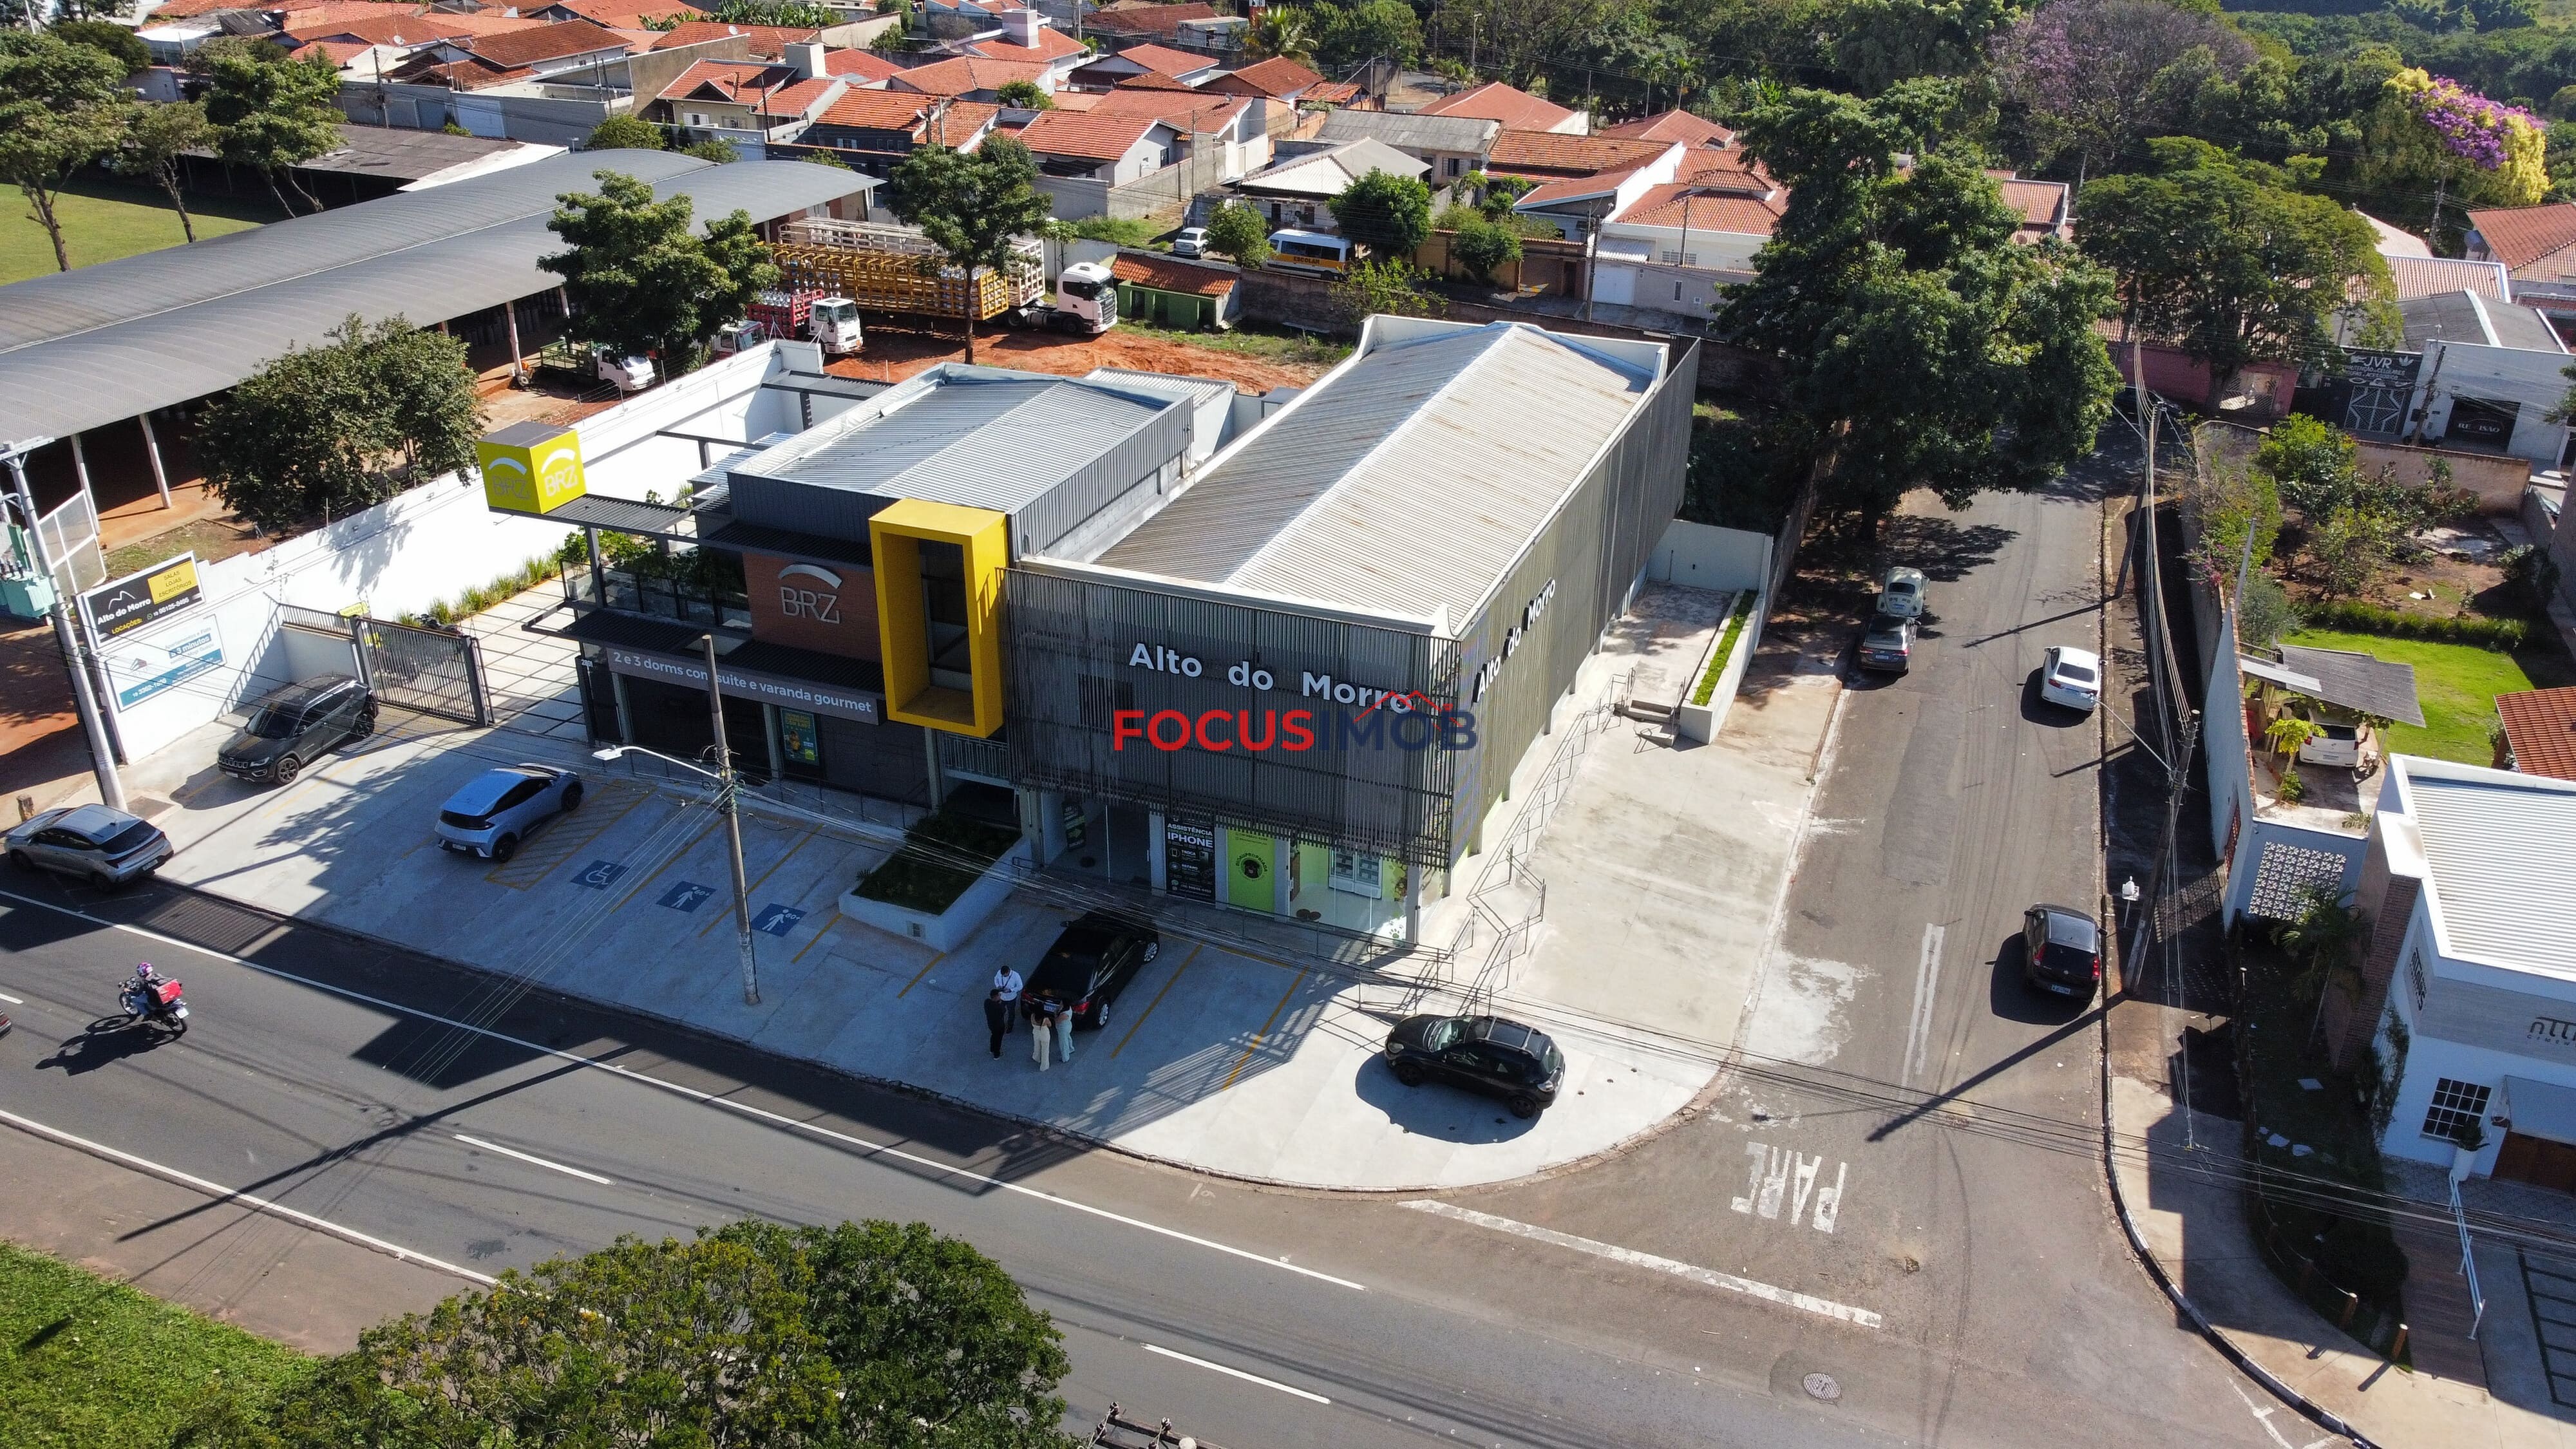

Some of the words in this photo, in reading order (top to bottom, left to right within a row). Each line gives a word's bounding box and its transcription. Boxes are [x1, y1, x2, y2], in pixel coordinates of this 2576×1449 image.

[2363, 356, 2392, 369] JVR
[492, 475, 530, 500] BRZ
[544, 465, 578, 497] BRZ
[164, 571, 180, 581] SALAS
[166, 577, 182, 587] LOJAS
[97, 613, 115, 625] Alto
[115, 607, 127, 618] do
[127, 598, 151, 612] Morro
[780, 586, 840, 624] BRZ
[182, 636, 209, 652] minutos
[1477, 655, 1501, 703] Alto
[1508, 627, 1522, 657] do
[1528, 579, 1556, 630] Morro
[613, 652, 622, 663] 2
[624, 657, 632, 665] e
[633, 656, 642, 667] 3
[643, 658, 684, 676] dorms
[749, 681, 757, 690] e
[759, 682, 812, 701] varanda
[814, 692, 872, 713] gourmet
[1129, 643, 1202, 677] Alto
[1228, 661, 1274, 690] do
[1303, 671, 1414, 715] Morro
[1167, 831, 1214, 849] IPHONE
